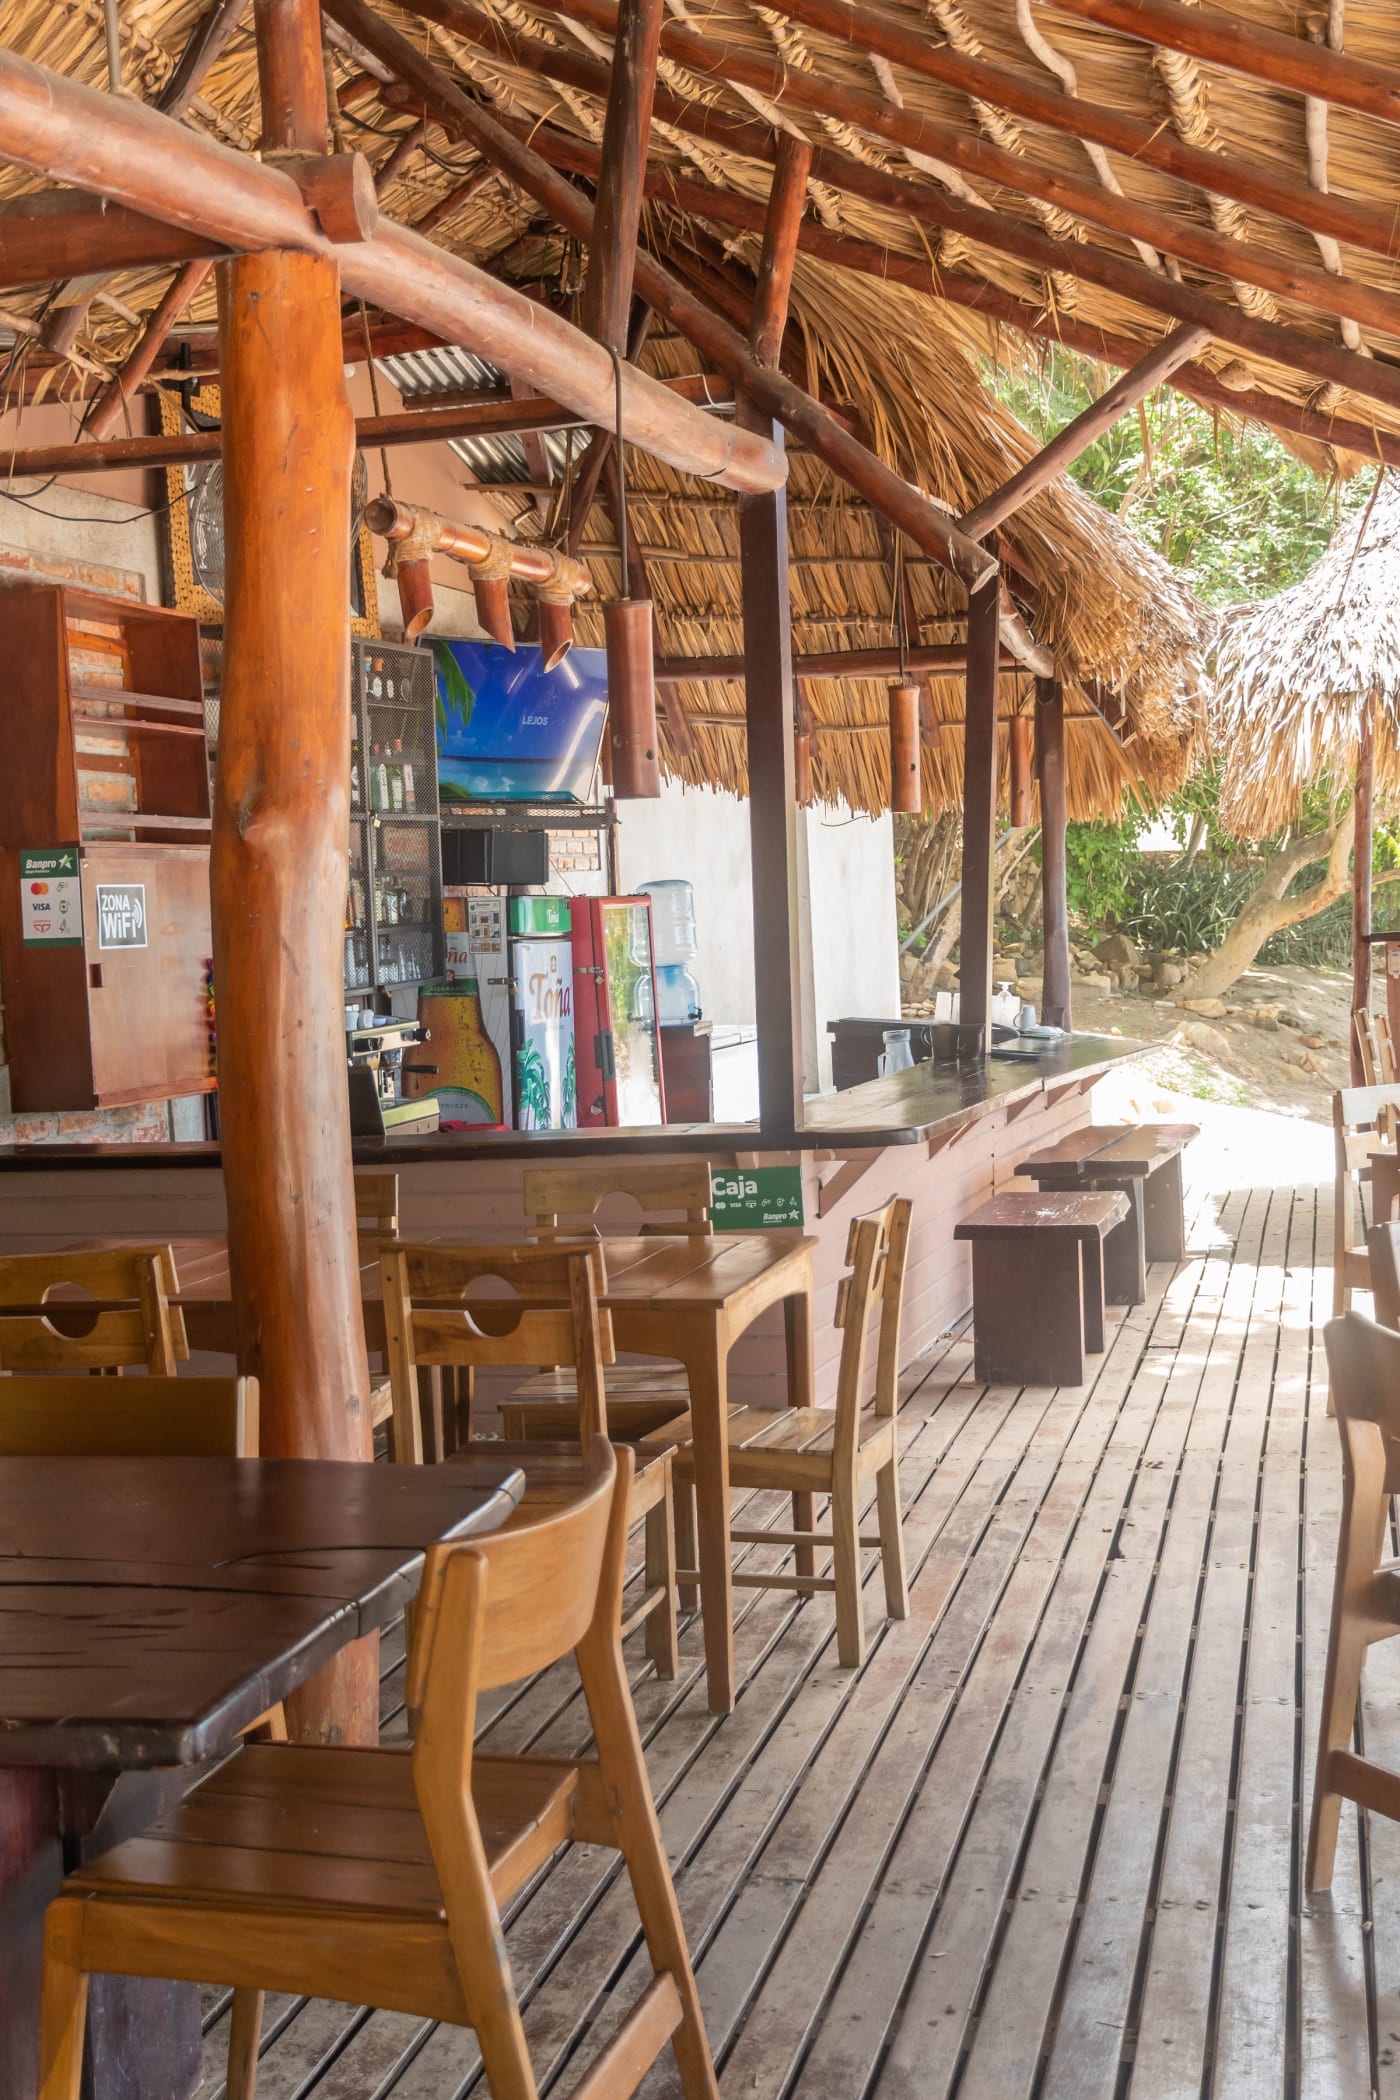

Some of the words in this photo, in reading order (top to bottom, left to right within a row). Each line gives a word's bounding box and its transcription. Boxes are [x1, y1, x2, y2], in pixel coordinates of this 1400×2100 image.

[522, 715, 549, 726] LEJOS
[26, 859, 57, 870] Banpro
[32, 903, 51, 911] VISA
[101, 894, 131, 911] ZONA
[102, 912, 137, 939] WiFi
[447, 946, 468, 964] ña
[529, 970, 571, 1020] Toña
[712, 1175, 758, 1199] Caja
